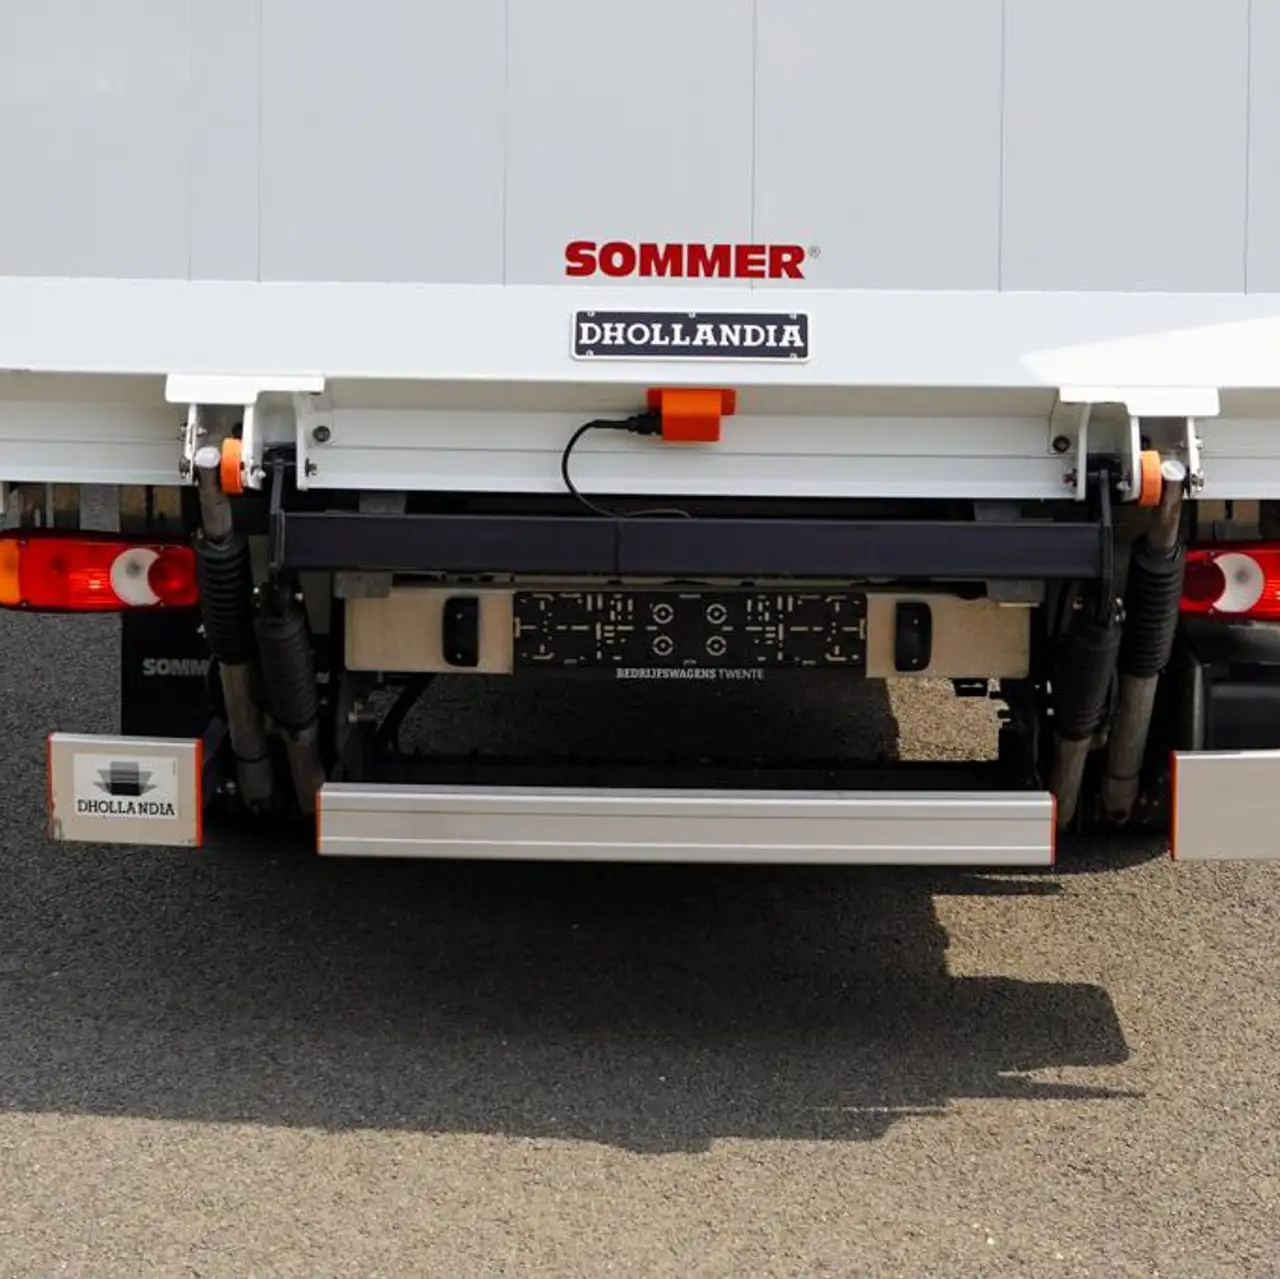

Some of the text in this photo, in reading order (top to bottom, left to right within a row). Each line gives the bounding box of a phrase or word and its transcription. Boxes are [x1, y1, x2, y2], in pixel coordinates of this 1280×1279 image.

[579, 322, 804, 347] DHOLLANDIA
[142, 658, 210, 676] SOMM
[616, 668, 764, 680] BEDRIJFSWAGENS TWENTE
[77, 799, 175, 816] DHOLLANDIA
